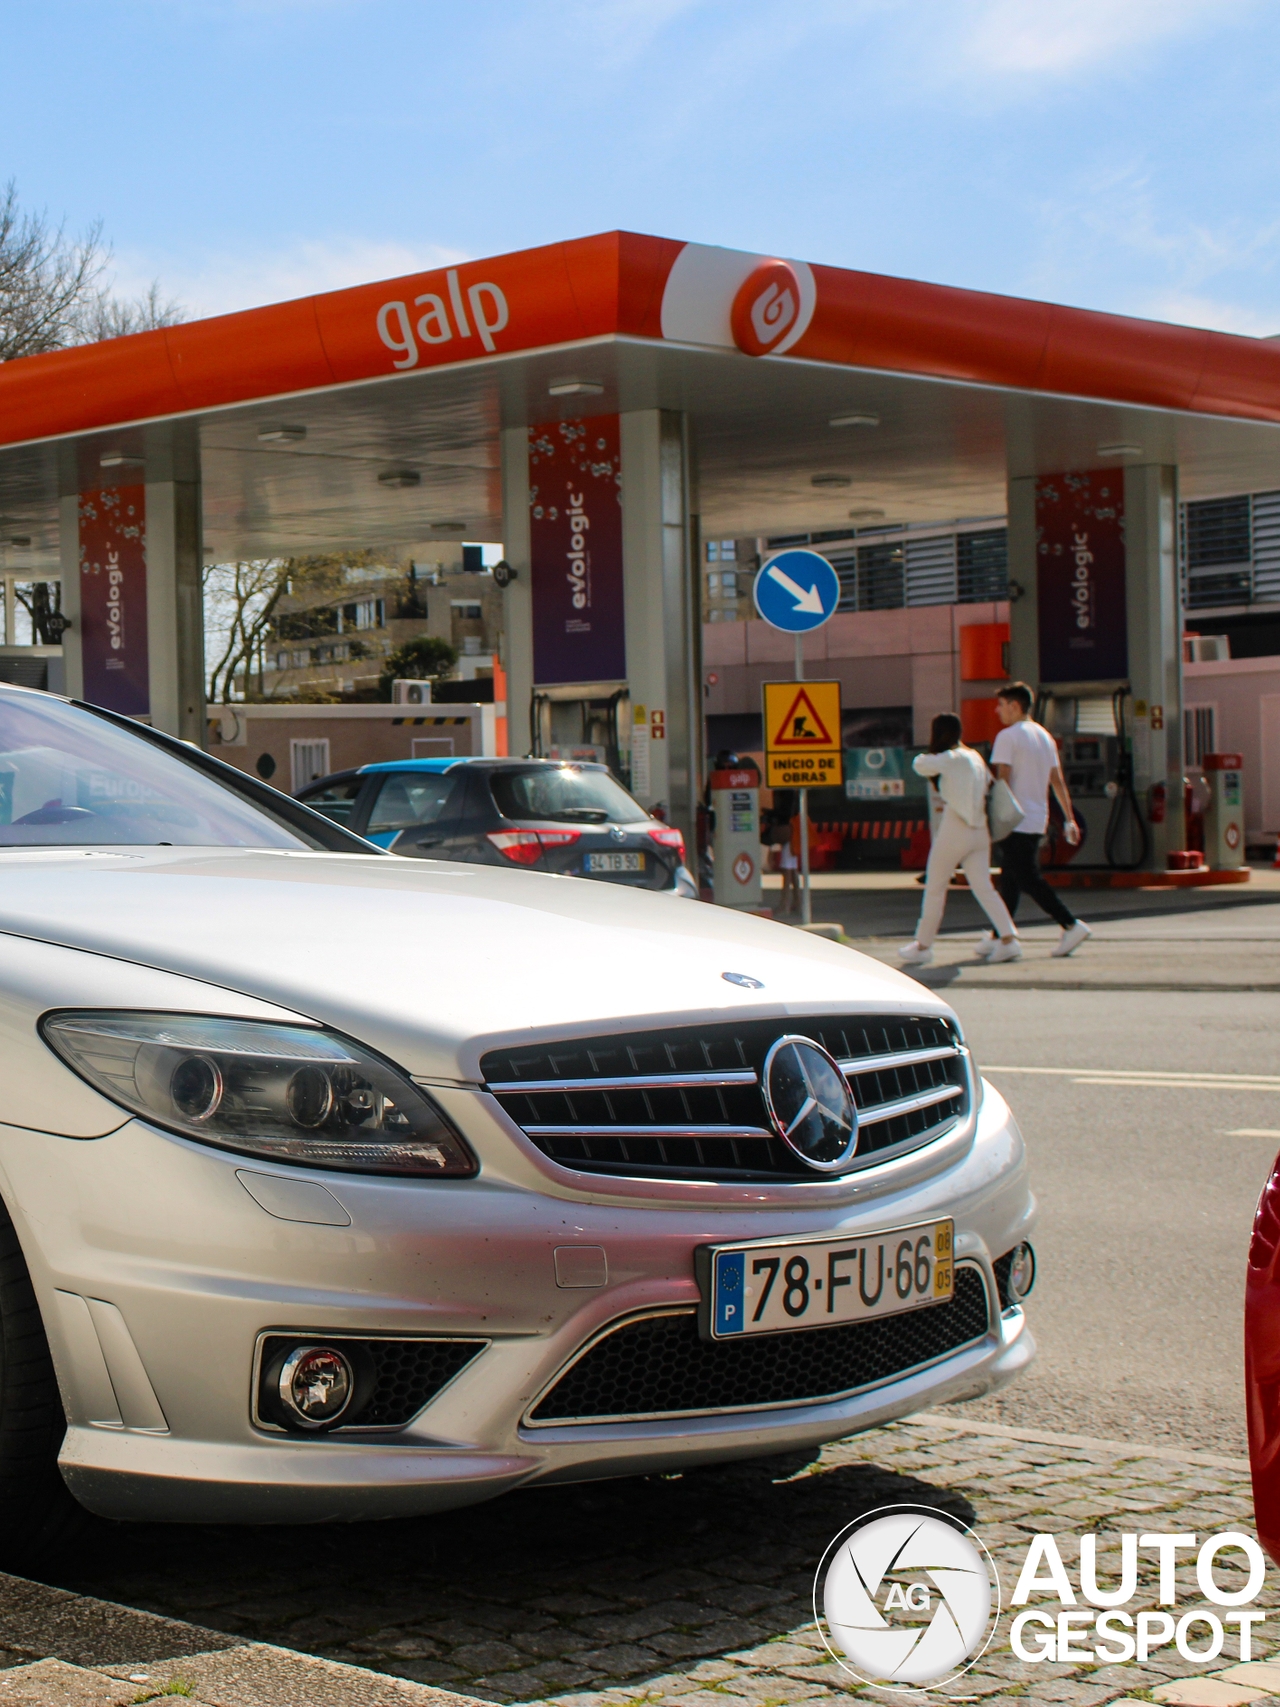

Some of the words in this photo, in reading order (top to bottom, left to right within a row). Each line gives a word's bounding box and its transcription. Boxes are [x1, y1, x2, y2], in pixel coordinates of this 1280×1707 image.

[376, 268, 509, 370] galp
[566, 492, 590, 610] evologic
[1070, 532, 1094, 629] evologic
[106, 551, 124, 650] evologic
[773, 757, 815, 770] INÍCIO
[819, 757, 836, 769] DE
[782, 771, 828, 783] OBRAS
[937, 1231, 951, 1252] 08
[937, 1268, 951, 1290] 05
[725, 1304, 736, 1321] P
